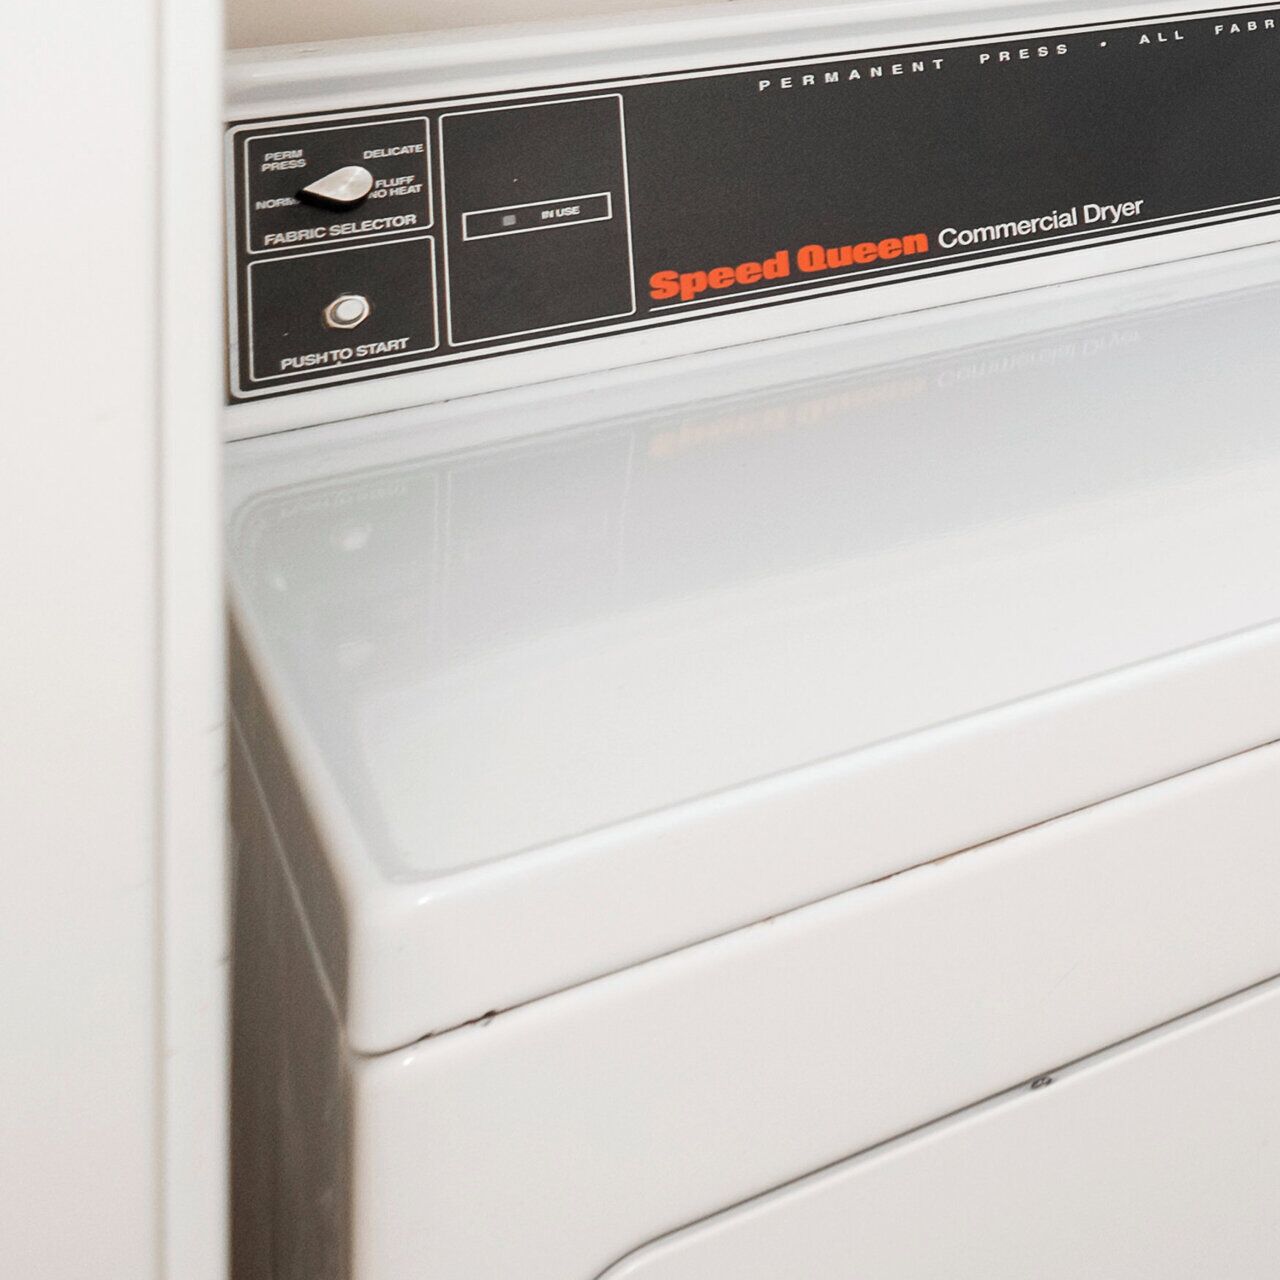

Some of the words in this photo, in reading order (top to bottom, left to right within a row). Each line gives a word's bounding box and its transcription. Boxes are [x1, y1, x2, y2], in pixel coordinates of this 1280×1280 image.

[758, 58, 944, 92] PERMANENT
[979, 44, 1067, 64] PRESS
[1139, 30, 1184, 45] ALL
[264, 149, 303, 162] PERM
[363, 143, 425, 160] DELICATE
[261, 158, 307, 172] PRESS
[374, 175, 416, 189] FLUFF
[368, 188, 388, 199] NO
[389, 184, 423, 198] HEAT
[541, 208, 555, 220] IN
[555, 205, 581, 218] USE
[264, 226, 327, 246] FABRIC
[329, 213, 418, 237] SELECTOR
[649, 249, 791, 301] Speed
[796, 232, 930, 273] Queen
[937, 207, 1078, 249] Commercial
[1083, 199, 1145, 224] Dryer
[281, 352, 329, 371] PUSH
[329, 347, 354, 361] TO
[356, 337, 410, 357] START
